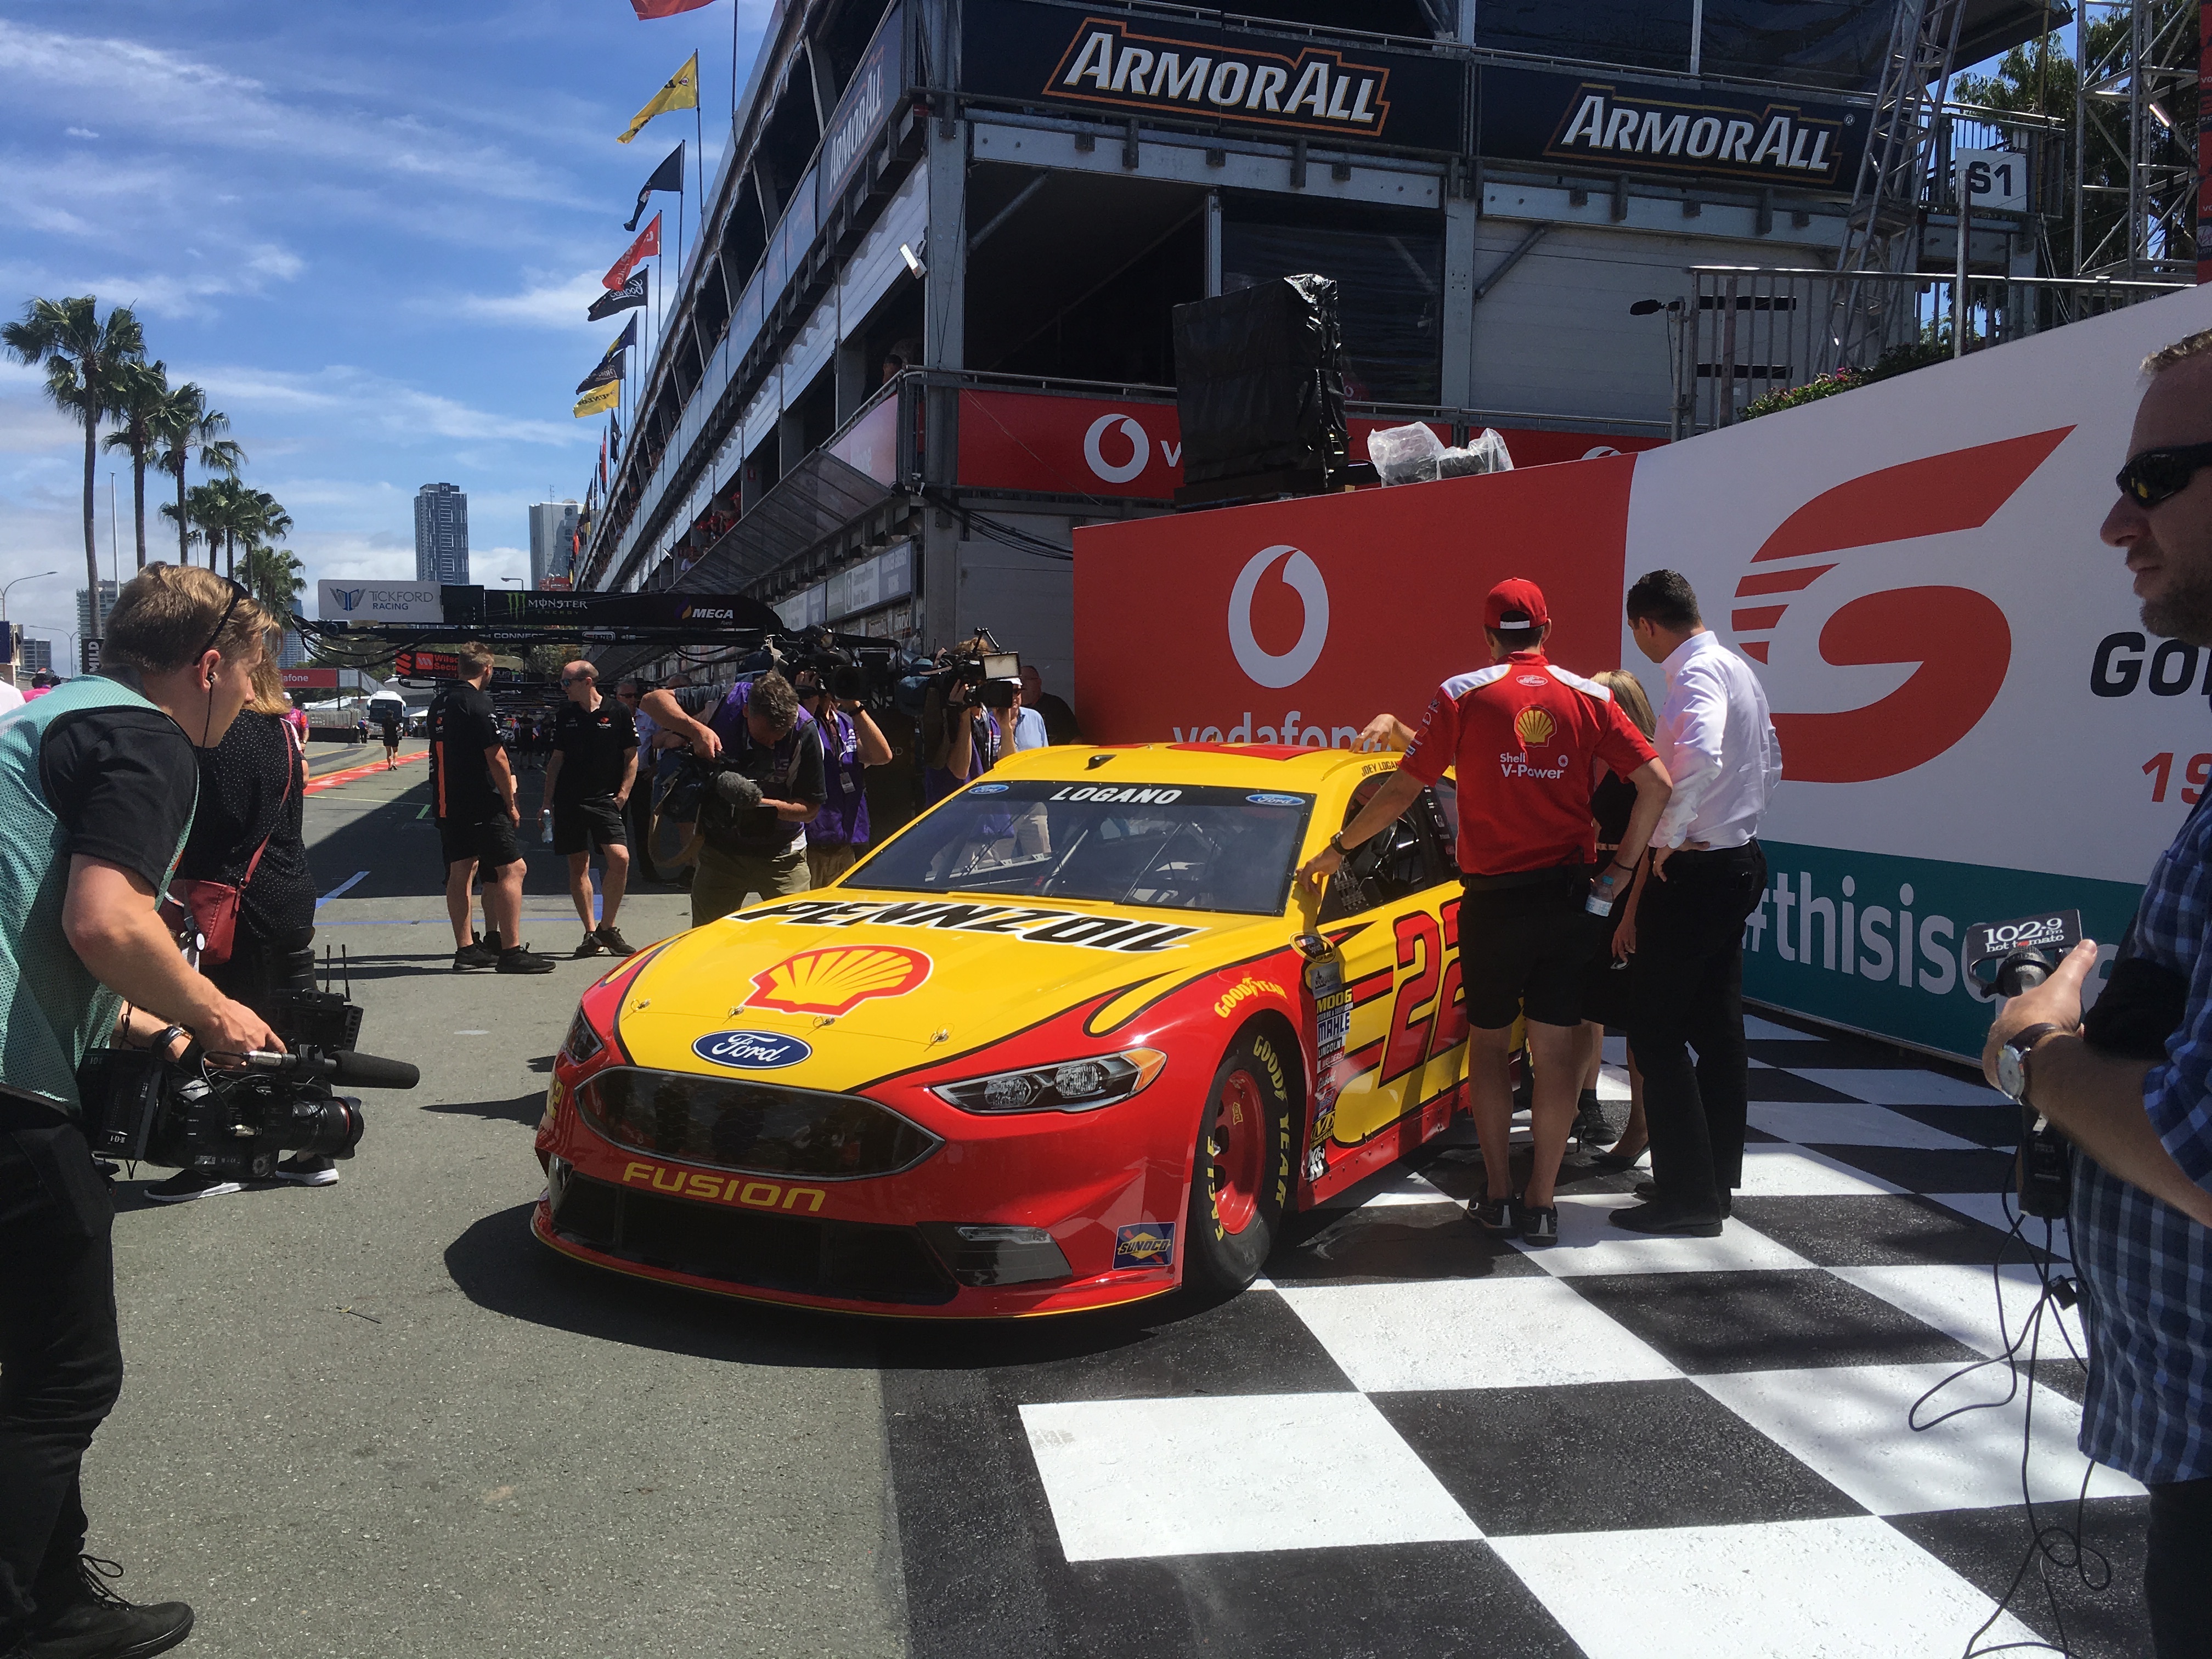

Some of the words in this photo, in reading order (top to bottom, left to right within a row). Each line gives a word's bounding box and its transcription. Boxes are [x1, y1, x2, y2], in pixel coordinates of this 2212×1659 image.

[1969, 161, 2012, 198] S1
[369, 591, 433, 602] TICKFORD
[528, 598, 588, 609] MONSTER
[692, 608, 733, 619] MEGA
[88, 641, 99, 673] MILD
[281, 674, 308, 682] afone
[1500, 752, 1526, 763] Shell
[1361, 763, 1377, 777] JOEY
[1501, 764, 1565, 780] V-Power
[1049, 786, 1184, 805] LOGANO
[731, 901, 1208, 952] PENNZOIL
[1985, 941, 2010, 953] hot
[1214, 977, 1288, 1018] GOODYEAR
[1317, 988, 1352, 1014] MOOG
[1318, 1012, 1350, 1043] MAHLE
[1318, 1039, 1341, 1059] LINCOLN
[1322, 1051, 1343, 1068] WELDERS
[622, 1161, 827, 1212] FUSION
[1119, 1240, 1170, 1254] SUNOCO
